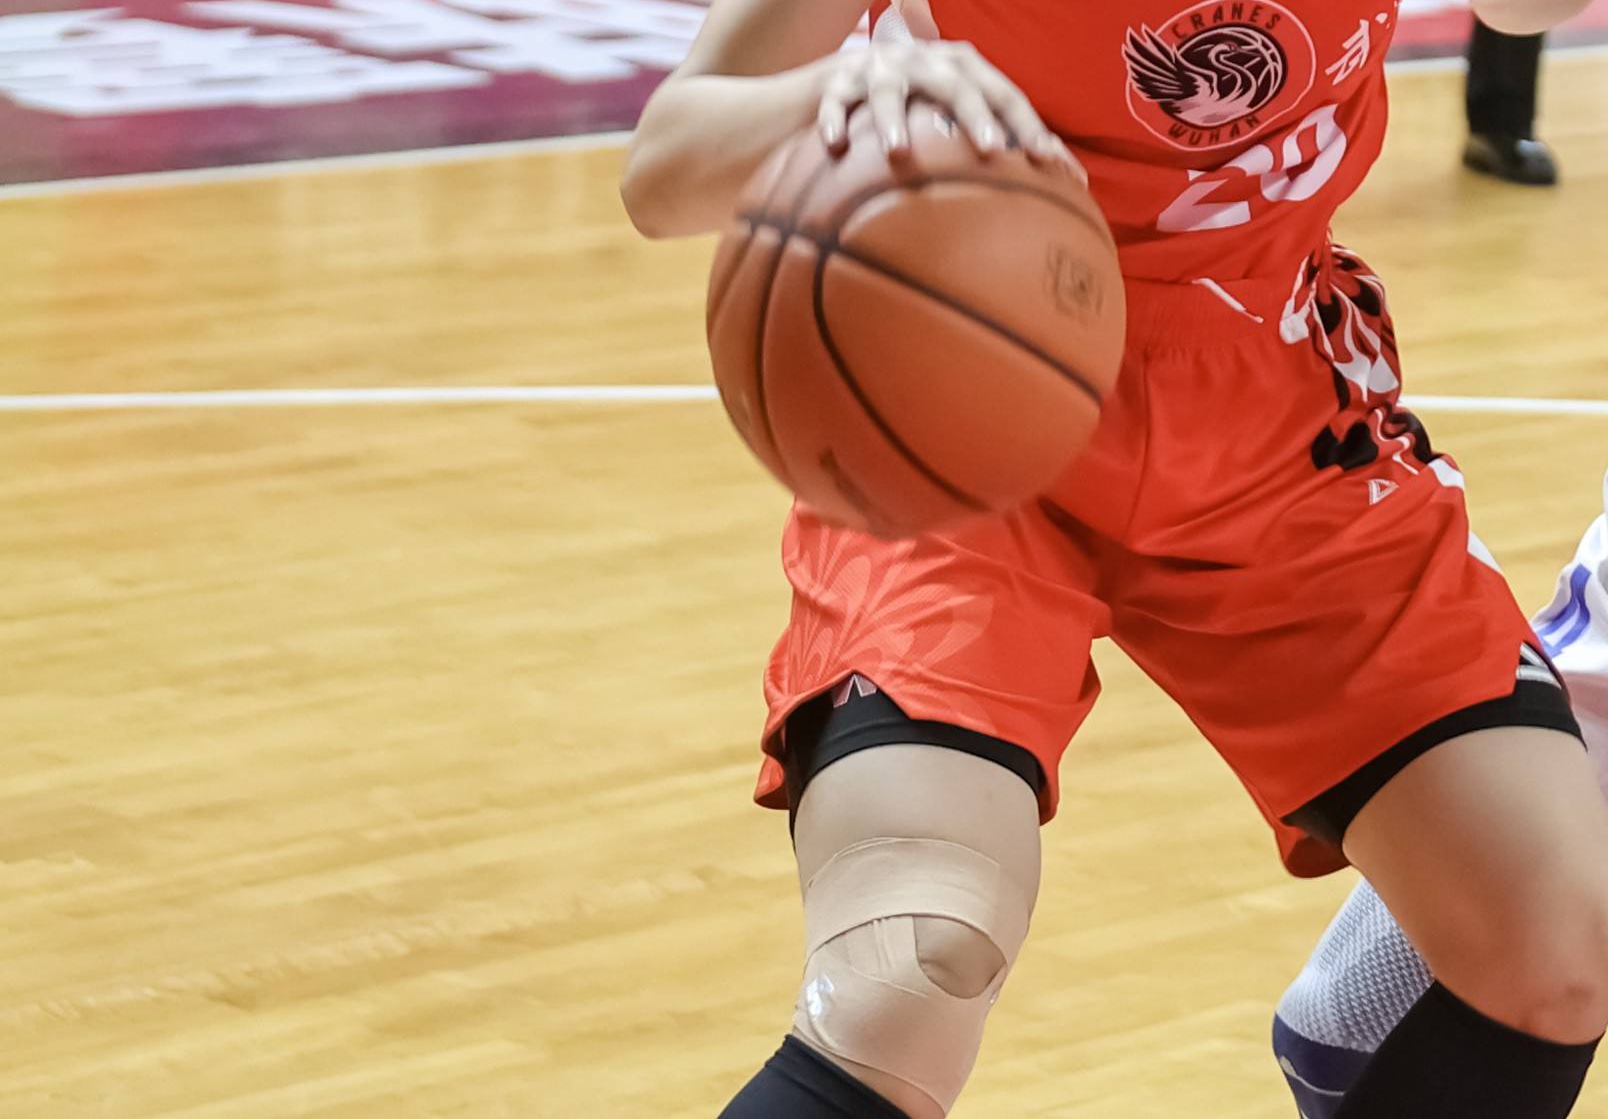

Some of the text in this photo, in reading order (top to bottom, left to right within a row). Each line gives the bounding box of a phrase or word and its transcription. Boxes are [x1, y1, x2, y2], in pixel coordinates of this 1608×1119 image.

[1171, 1, 1281, 40] CRANES
[1167, 113, 1261, 146] WUHAN
[1155, 104, 1348, 232] 20
